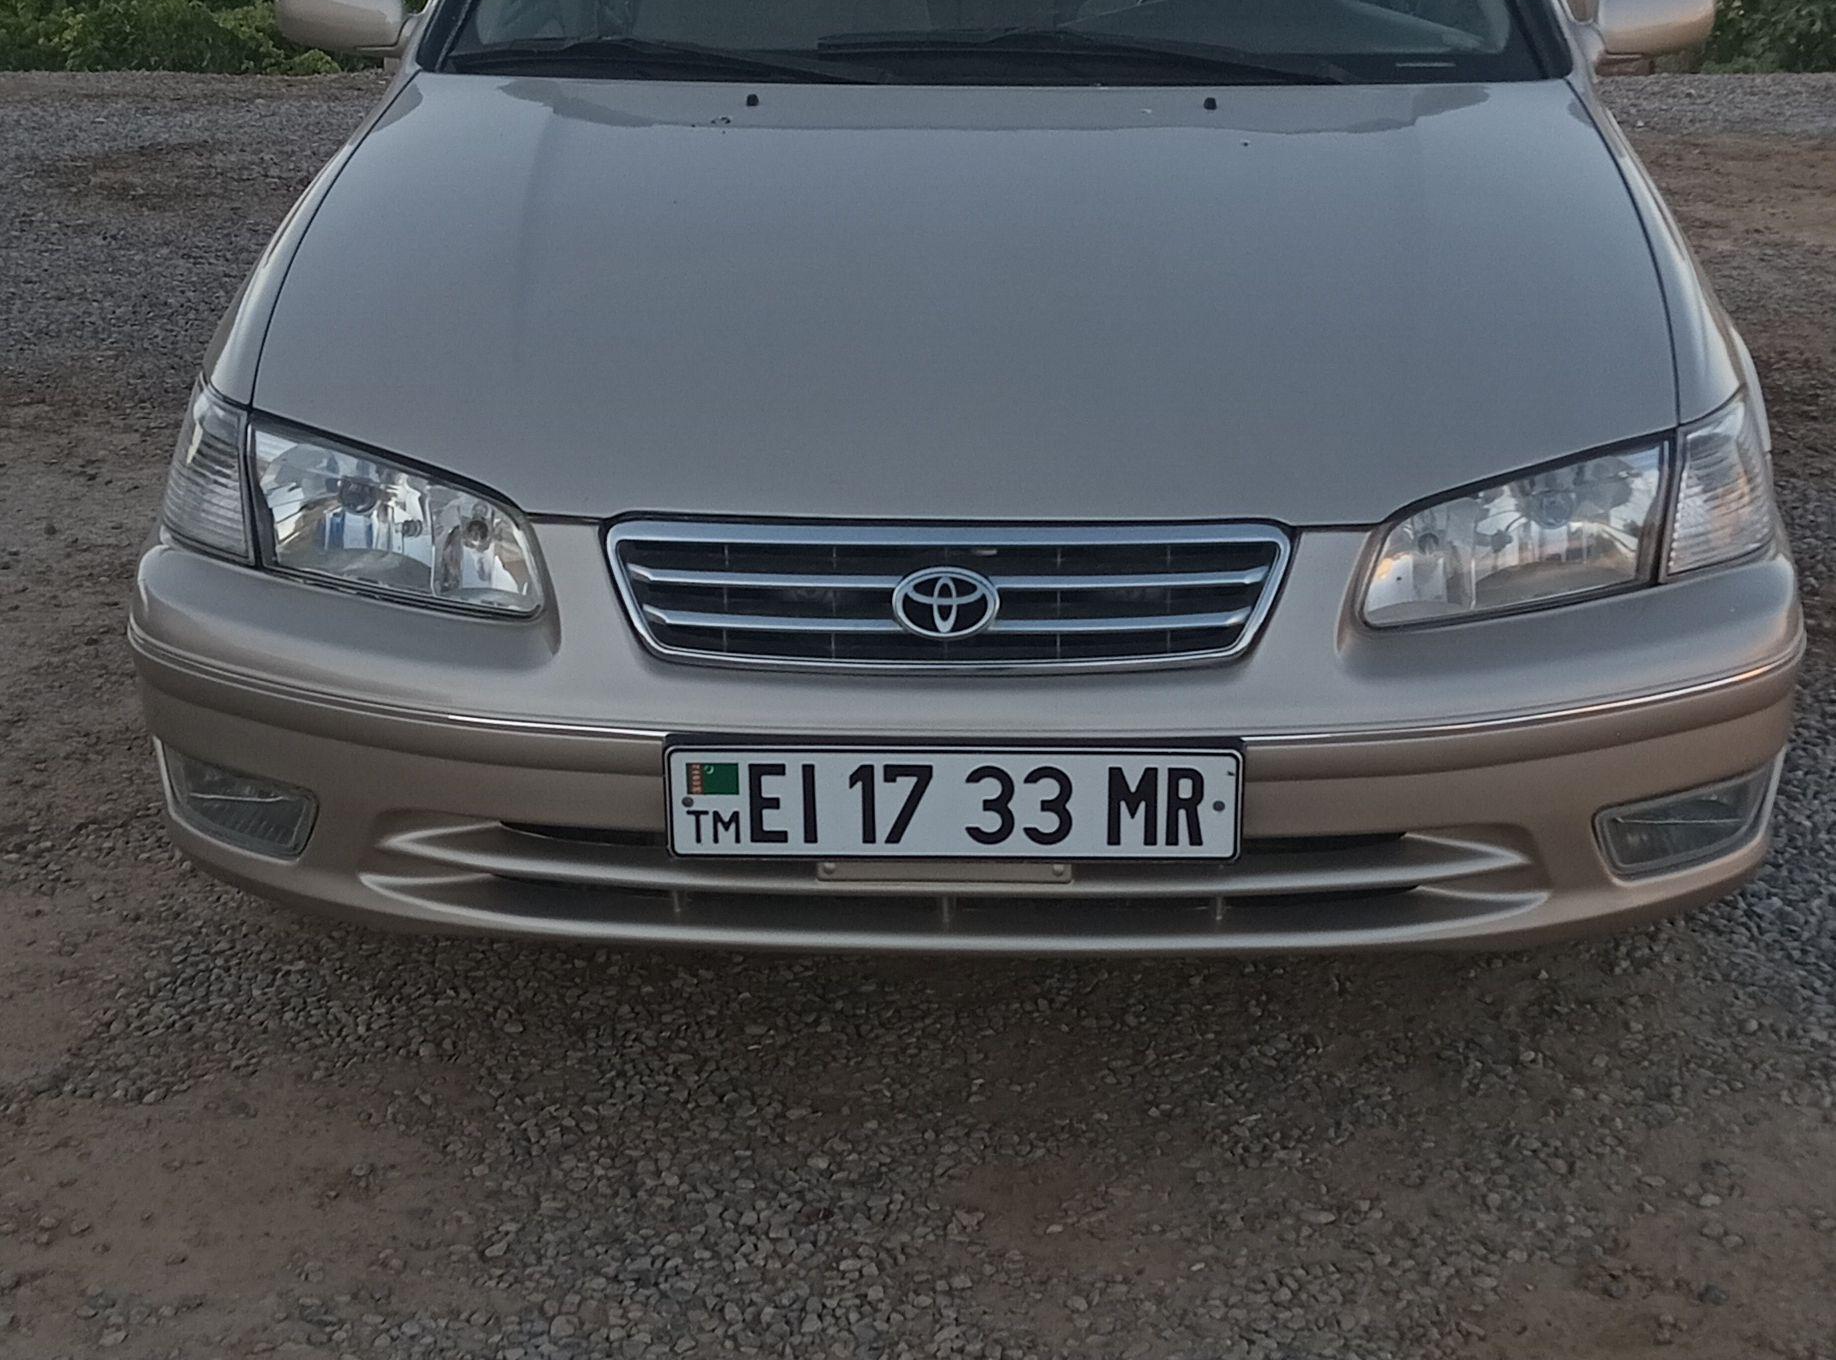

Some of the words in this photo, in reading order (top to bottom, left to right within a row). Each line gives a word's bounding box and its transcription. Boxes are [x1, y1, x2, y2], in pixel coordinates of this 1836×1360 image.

[686, 809, 741, 844] TM
[848, 764, 933, 844] 17
[964, 765, 1073, 846] 33
[1106, 766, 1205, 847] MR
